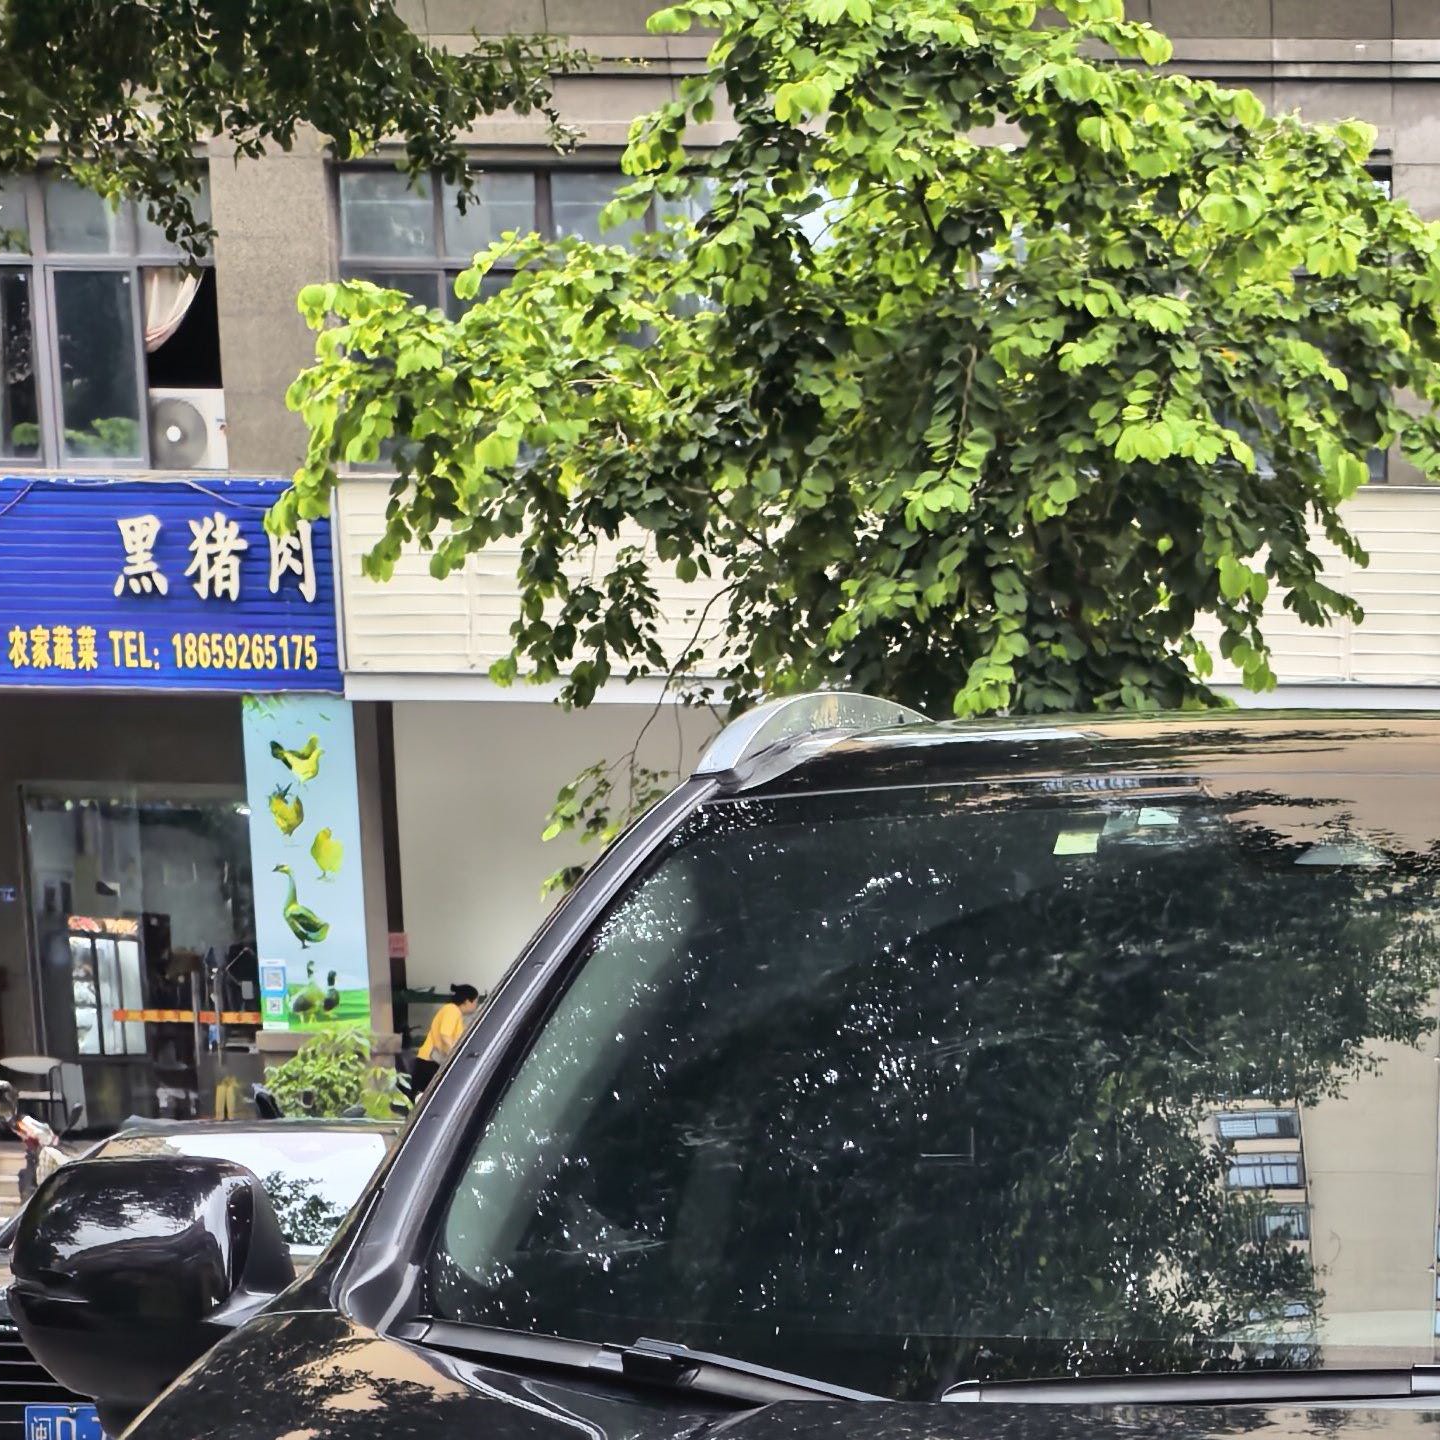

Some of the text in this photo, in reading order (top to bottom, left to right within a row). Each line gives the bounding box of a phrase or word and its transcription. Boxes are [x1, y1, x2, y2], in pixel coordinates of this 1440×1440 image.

[112, 511, 318, 603] 黑猪肉
[7, 624, 99, 672] 农家蔬菜
[171, 631, 319, 671] 18659265175
